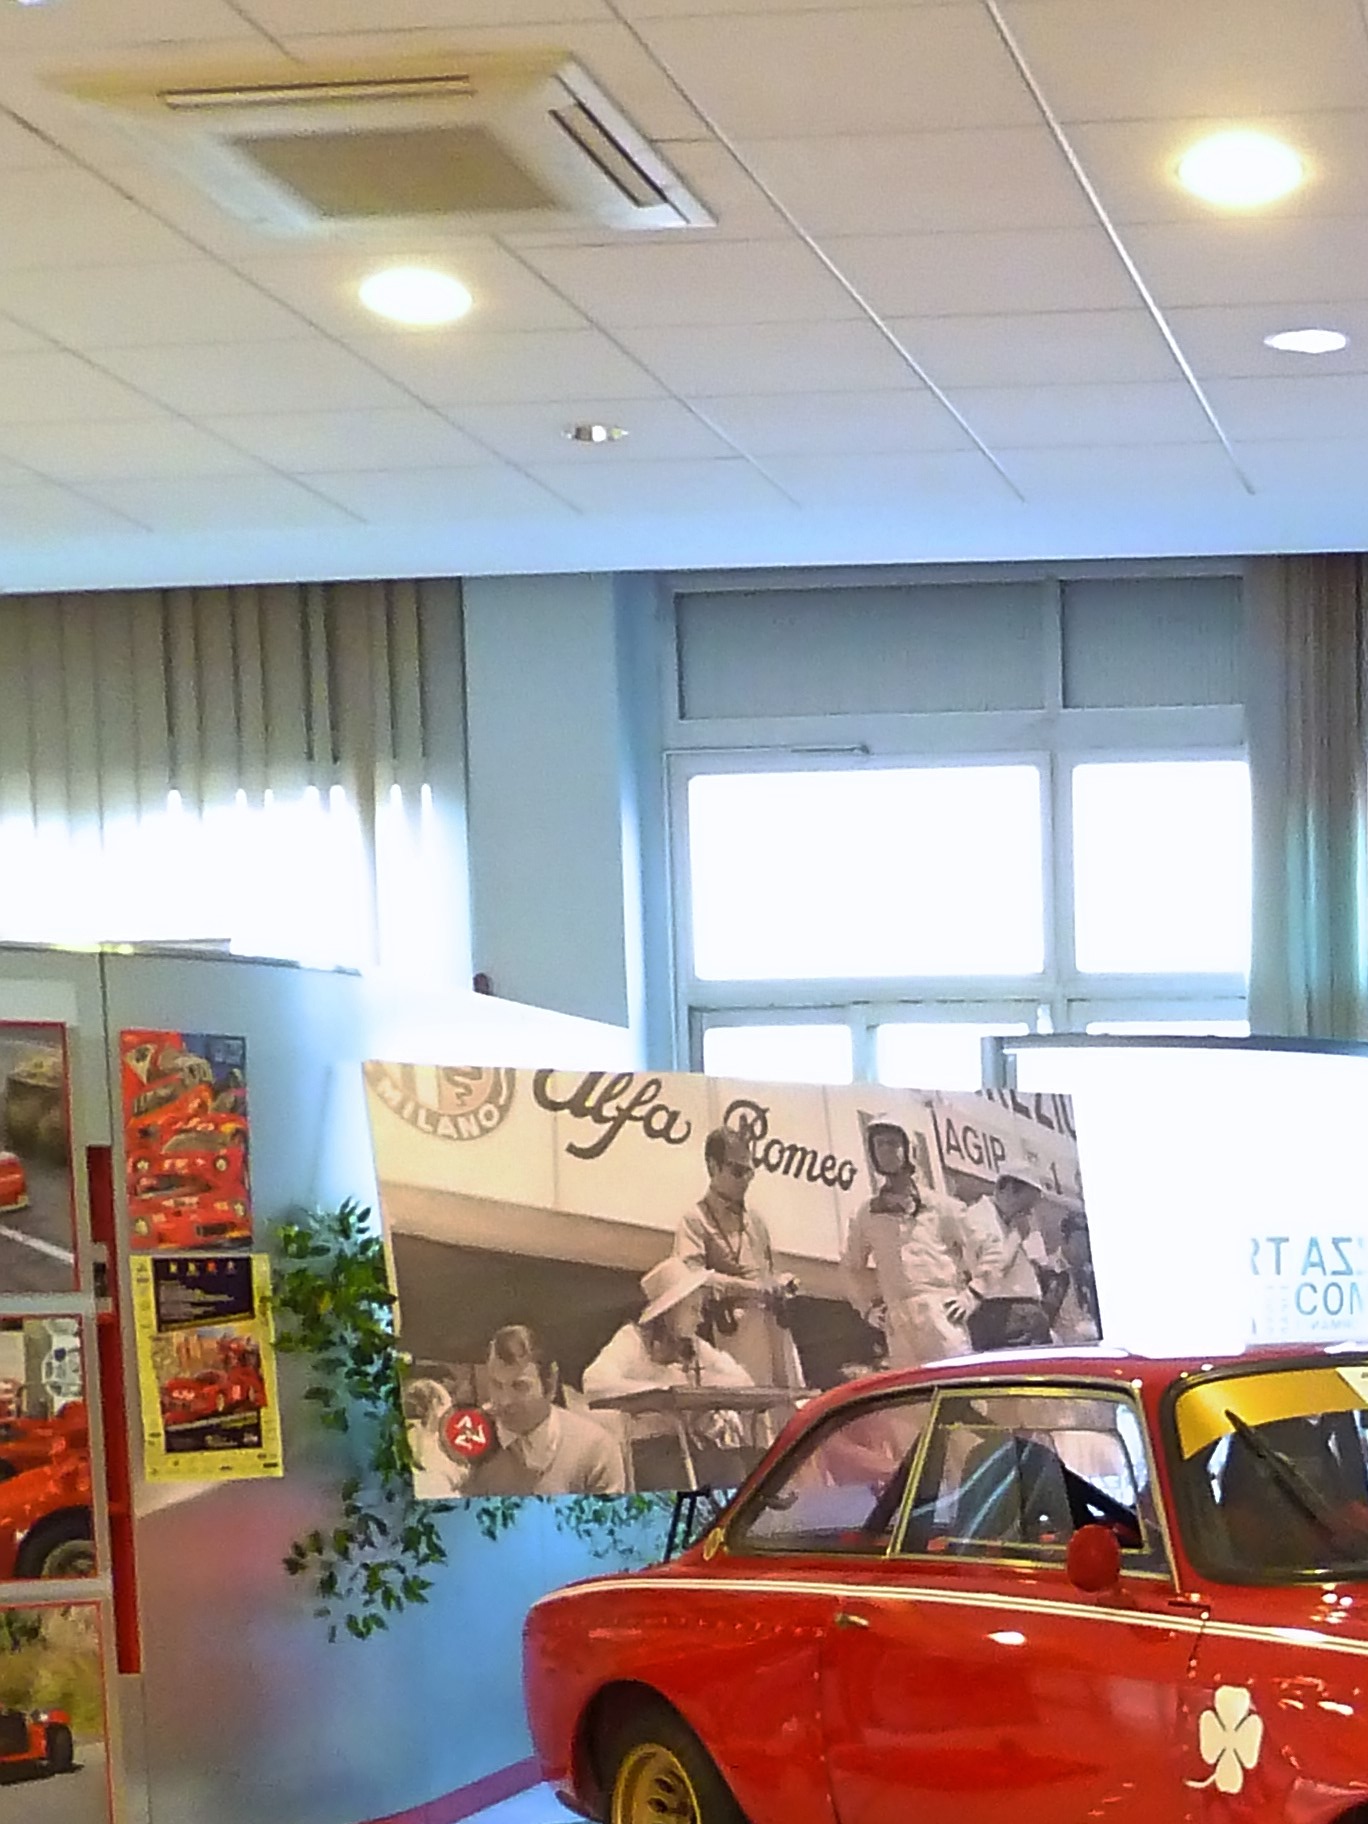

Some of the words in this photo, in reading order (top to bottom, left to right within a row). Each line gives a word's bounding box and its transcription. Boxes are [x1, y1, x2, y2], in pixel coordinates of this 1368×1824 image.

[378, 1078, 503, 1139] MILANO
[533, 1066, 692, 1160] Alfa
[723, 1099, 858, 1191] Romeo
[945, 1117, 1006, 1174] AGIP
